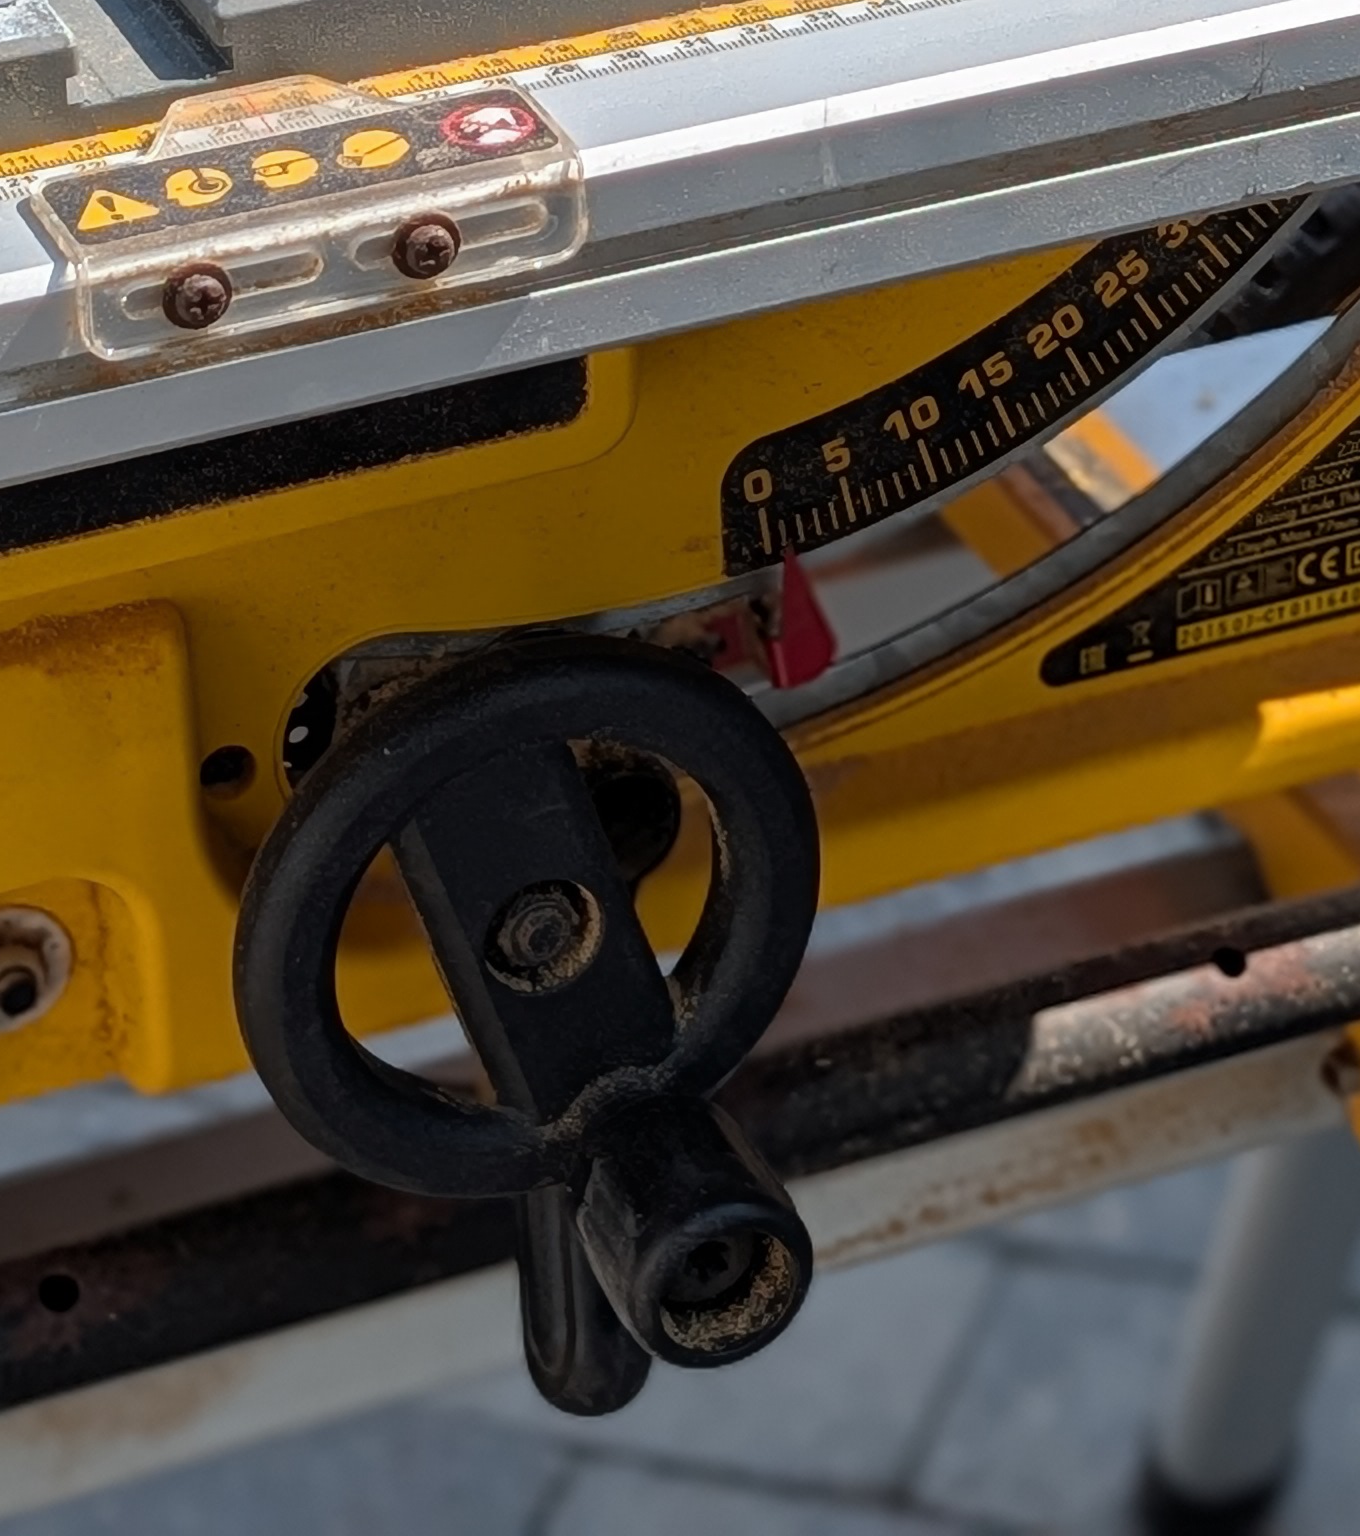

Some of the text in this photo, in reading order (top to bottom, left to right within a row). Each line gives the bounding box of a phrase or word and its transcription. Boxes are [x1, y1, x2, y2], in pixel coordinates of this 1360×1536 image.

[743, 218, 1204, 503] 0 5 10 15 20 25 3
